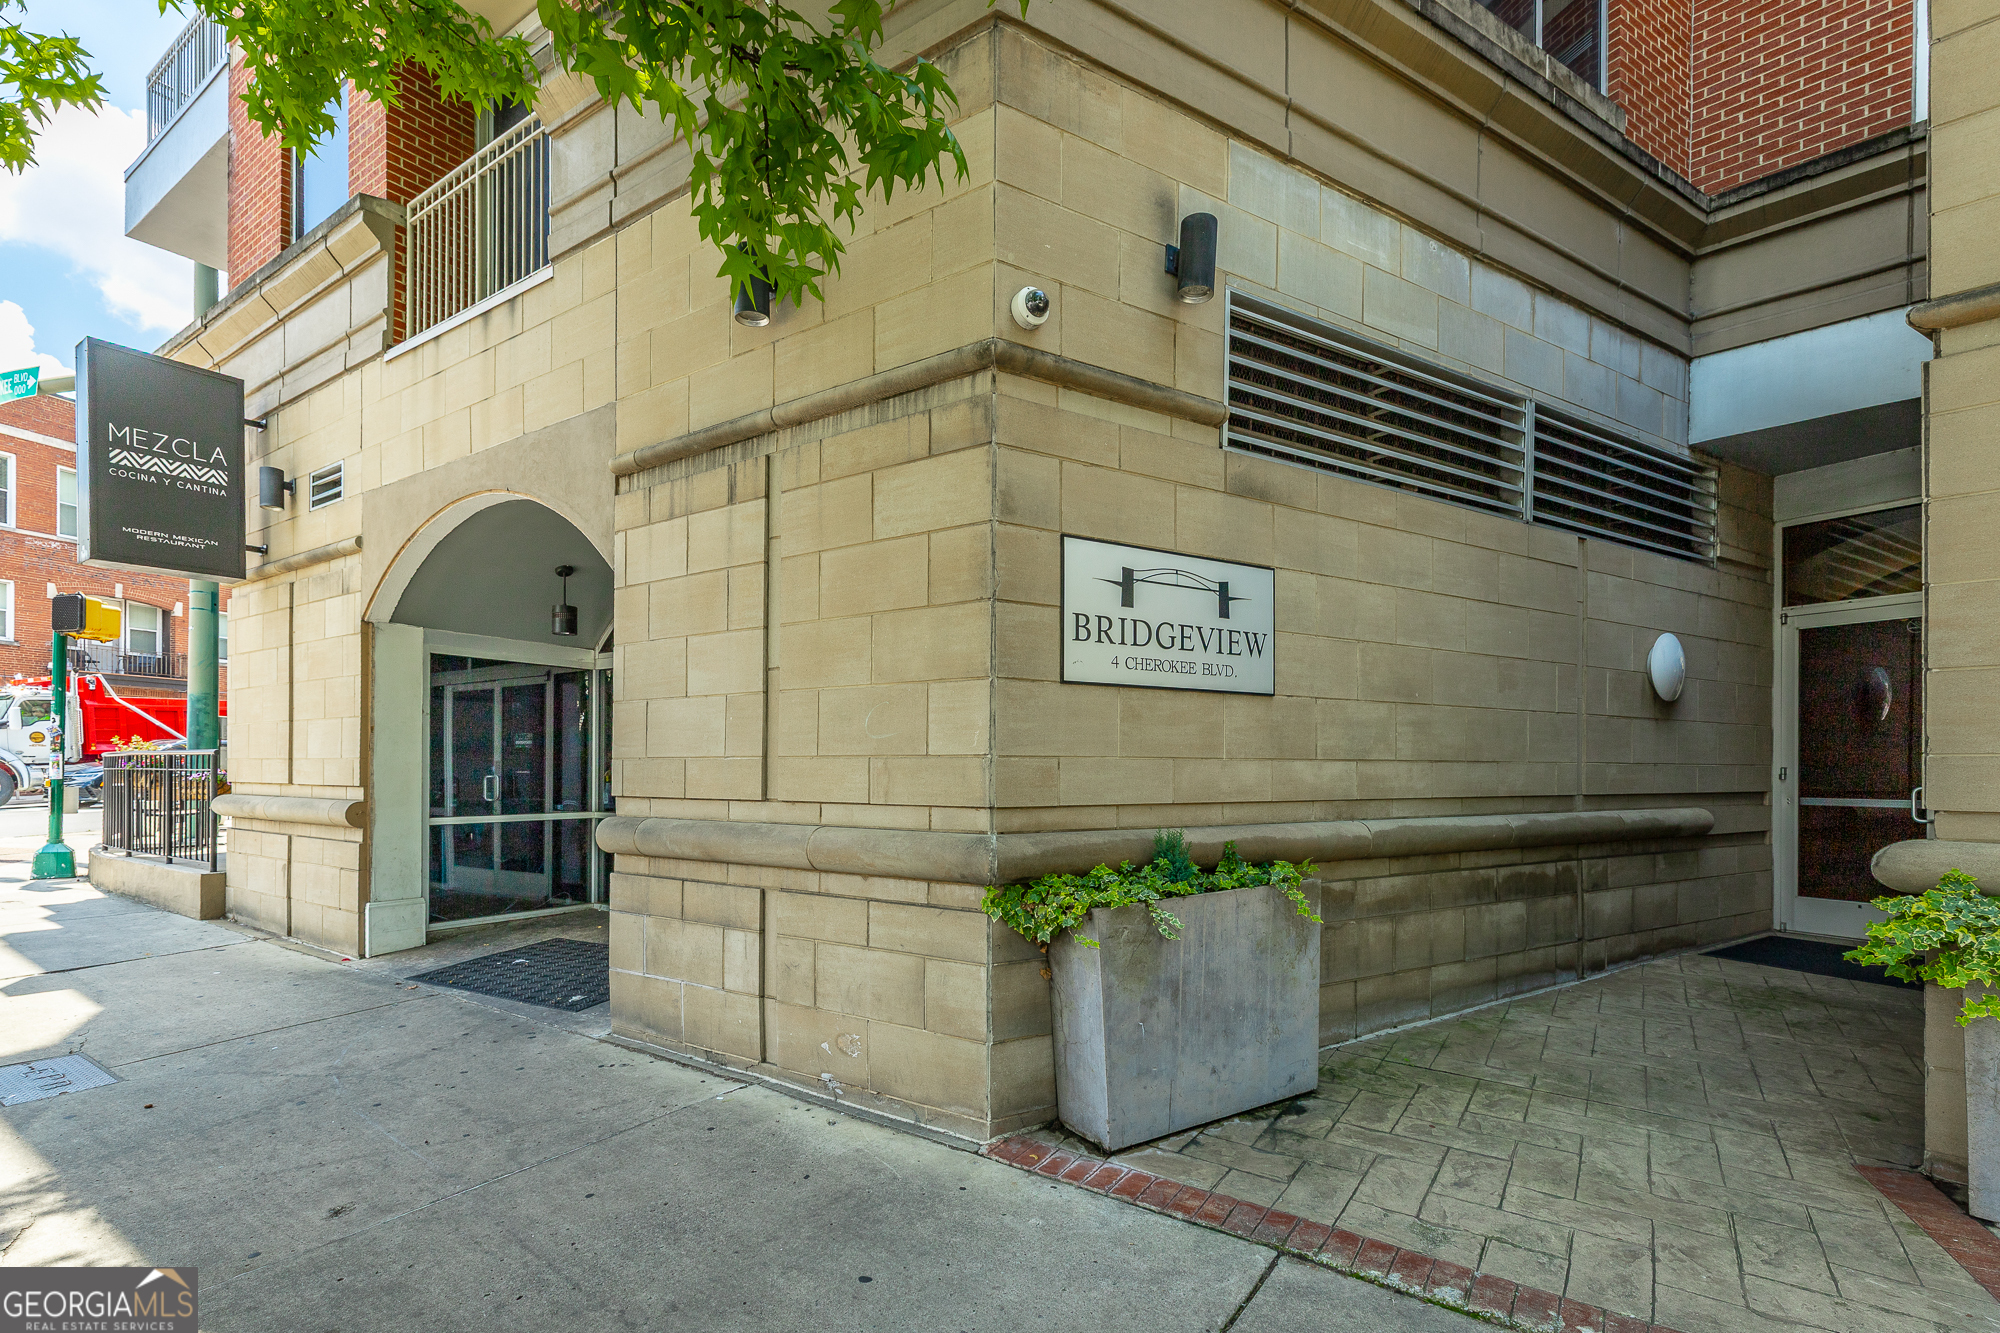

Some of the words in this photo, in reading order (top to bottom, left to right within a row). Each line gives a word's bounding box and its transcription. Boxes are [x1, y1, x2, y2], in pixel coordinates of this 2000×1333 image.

[13, 372, 28, 383] BLVD
[108, 422, 228, 467] MEZCLA
[108, 467, 157, 484] COCINA
[163, 477, 171, 486] Y
[176, 480, 227, 497] CANTINA
[122, 526, 169, 538] MODERN
[172, 534, 219, 546] MEXICAN
[136, 534, 206, 549] RESTAURANT
[1072, 612, 1268, 659] BRIDGEVIEW
[1110, 655, 1120, 669] 4
[1124, 656, 1198, 675] CHEROKEE
[1201, 662, 1238, 679] BLVD.
